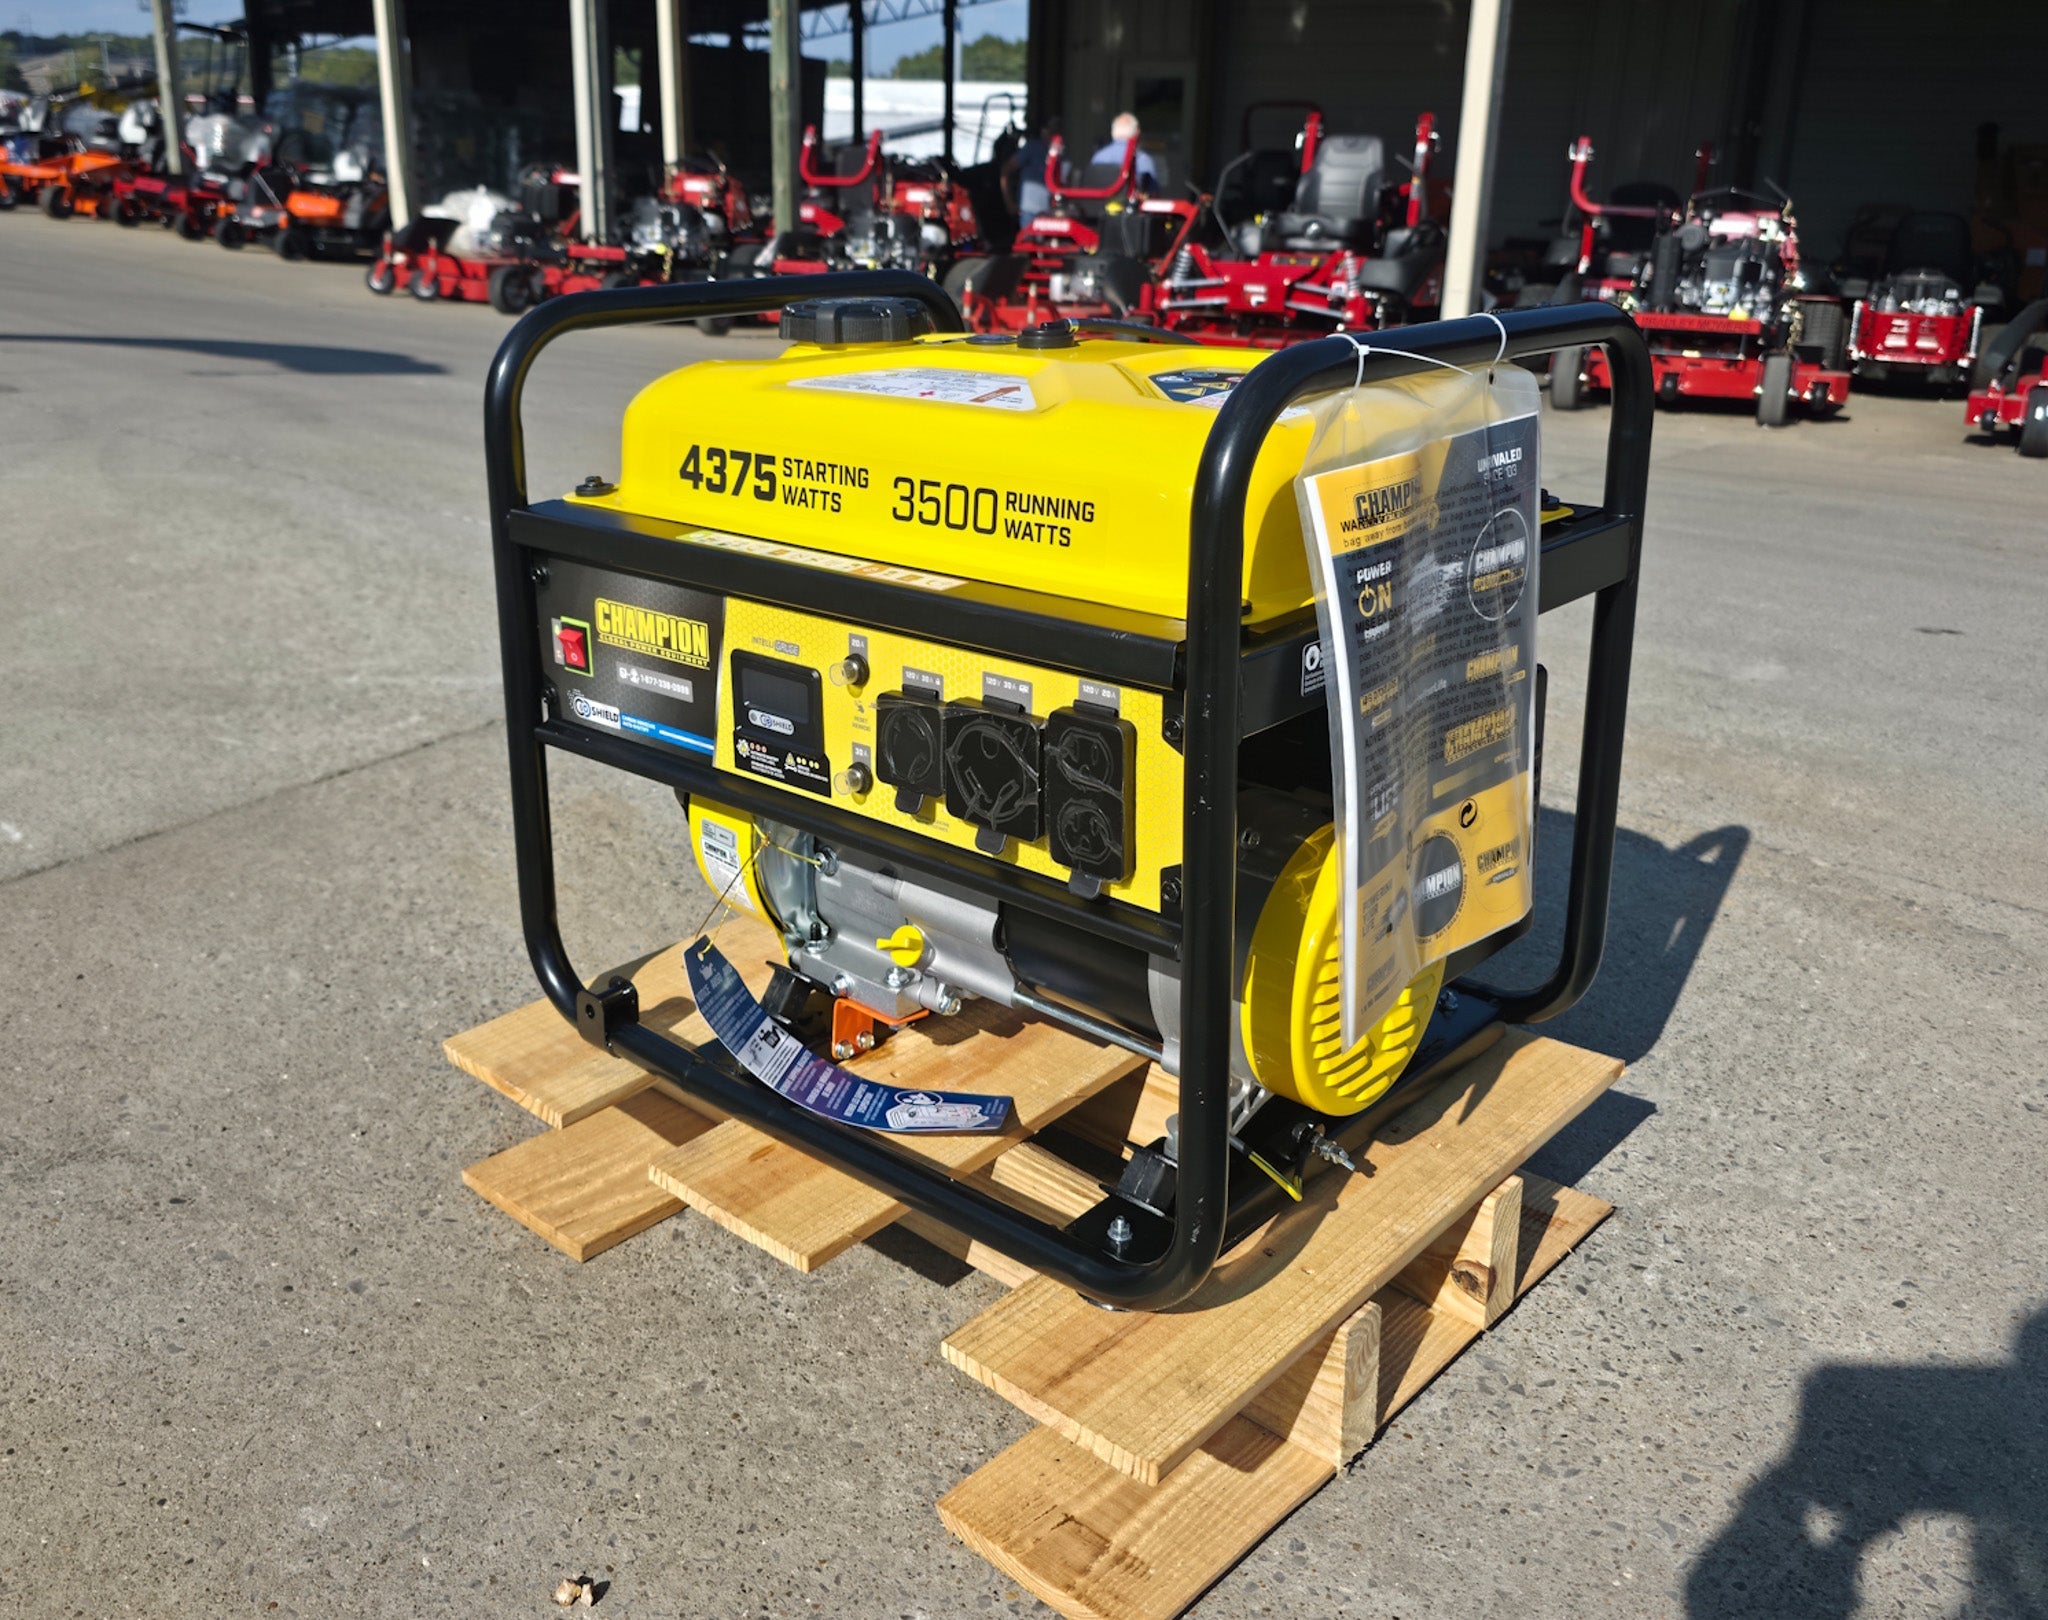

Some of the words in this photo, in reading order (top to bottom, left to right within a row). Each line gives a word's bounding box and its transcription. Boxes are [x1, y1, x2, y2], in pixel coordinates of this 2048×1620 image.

[679, 443, 777, 502] 4375
[782, 457, 870, 489] STARTING
[782, 483, 842, 514] WATTS
[892, 475, 998, 535] 3500
[1005, 490, 1095, 523] RUNNING
[1004, 517, 1071, 548] WATTS
[1343, 537, 1361, 548] bag
[1364, 529, 1384, 543] away
[1356, 560, 1393, 584] POWER
[1358, 580, 1394, 618] ON
[595, 598, 710, 661] CHAMPION
[591, 705, 619, 723] SHIELD
